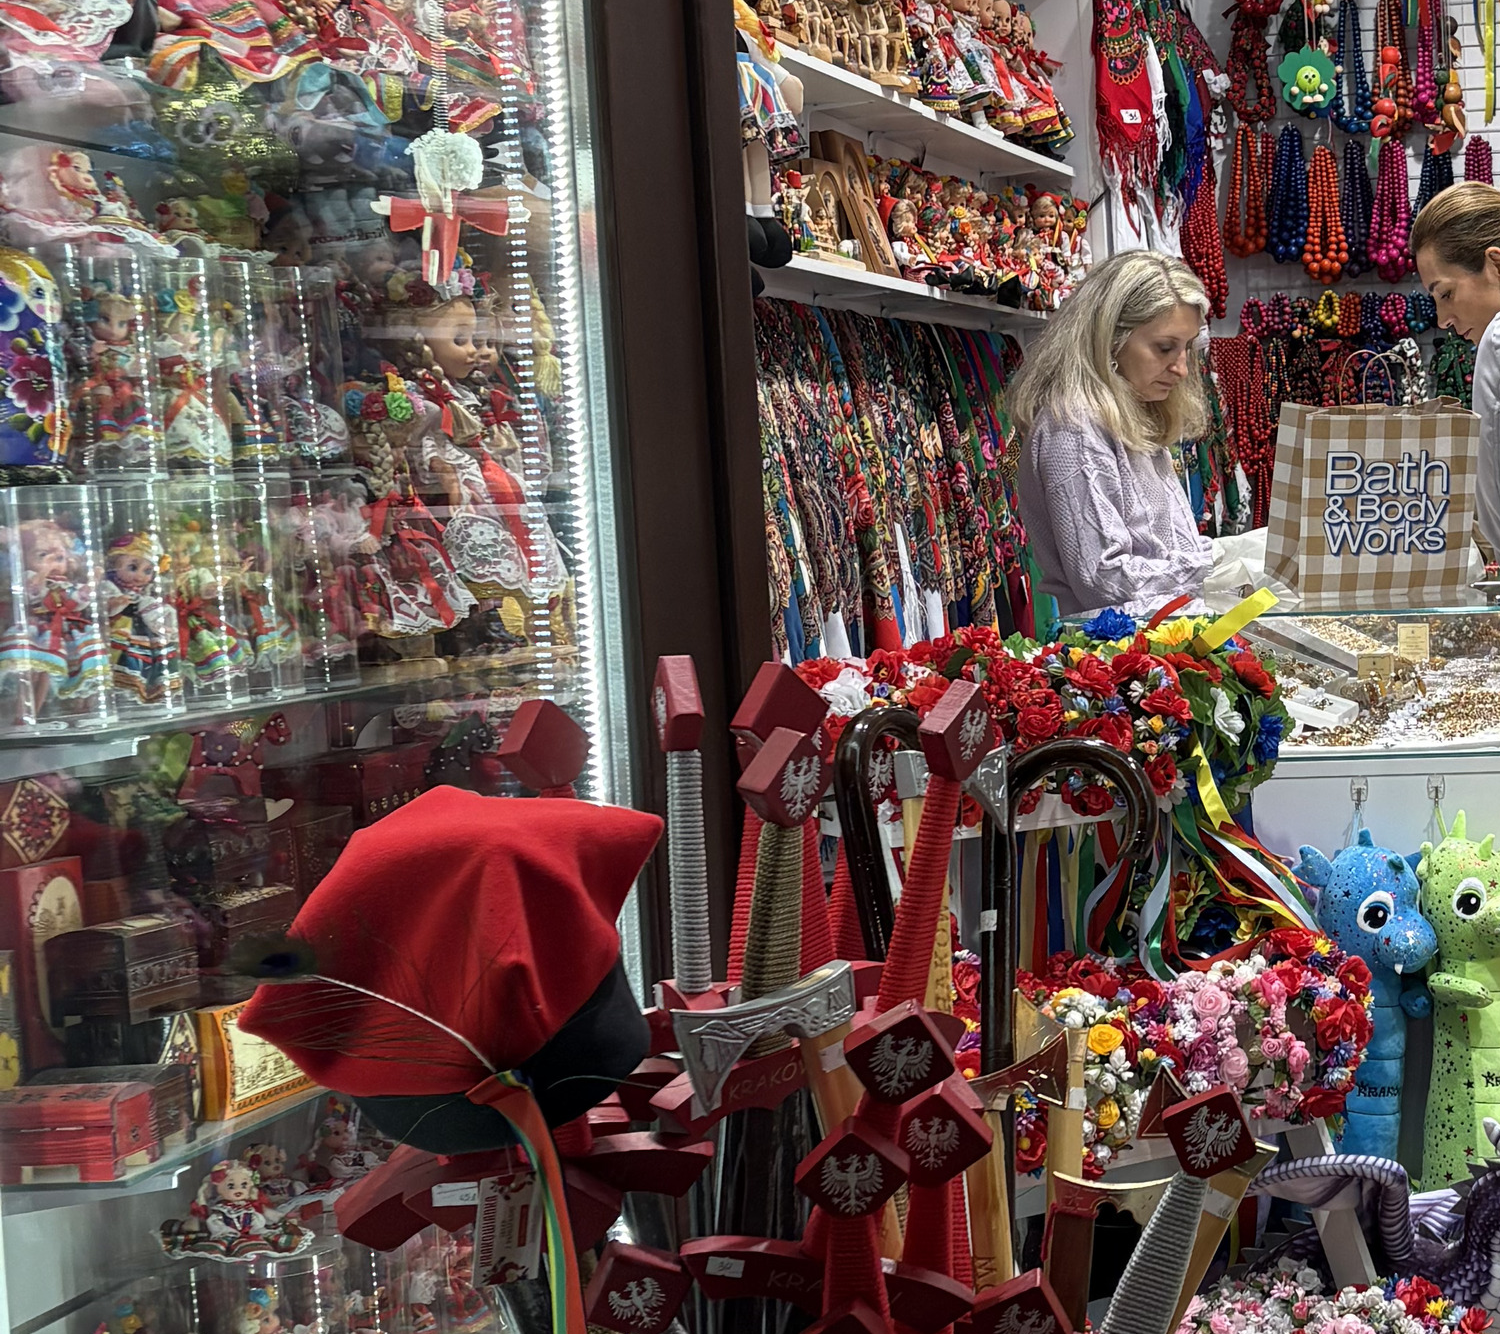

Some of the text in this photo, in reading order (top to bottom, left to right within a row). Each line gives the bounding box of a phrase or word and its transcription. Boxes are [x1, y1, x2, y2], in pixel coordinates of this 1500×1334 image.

[1325, 450, 1449, 495] Bath
[1323, 493, 1449, 528] & Body
[1323, 521, 1446, 556] Works
[728, 1053, 800, 1101] KRAKÓ
